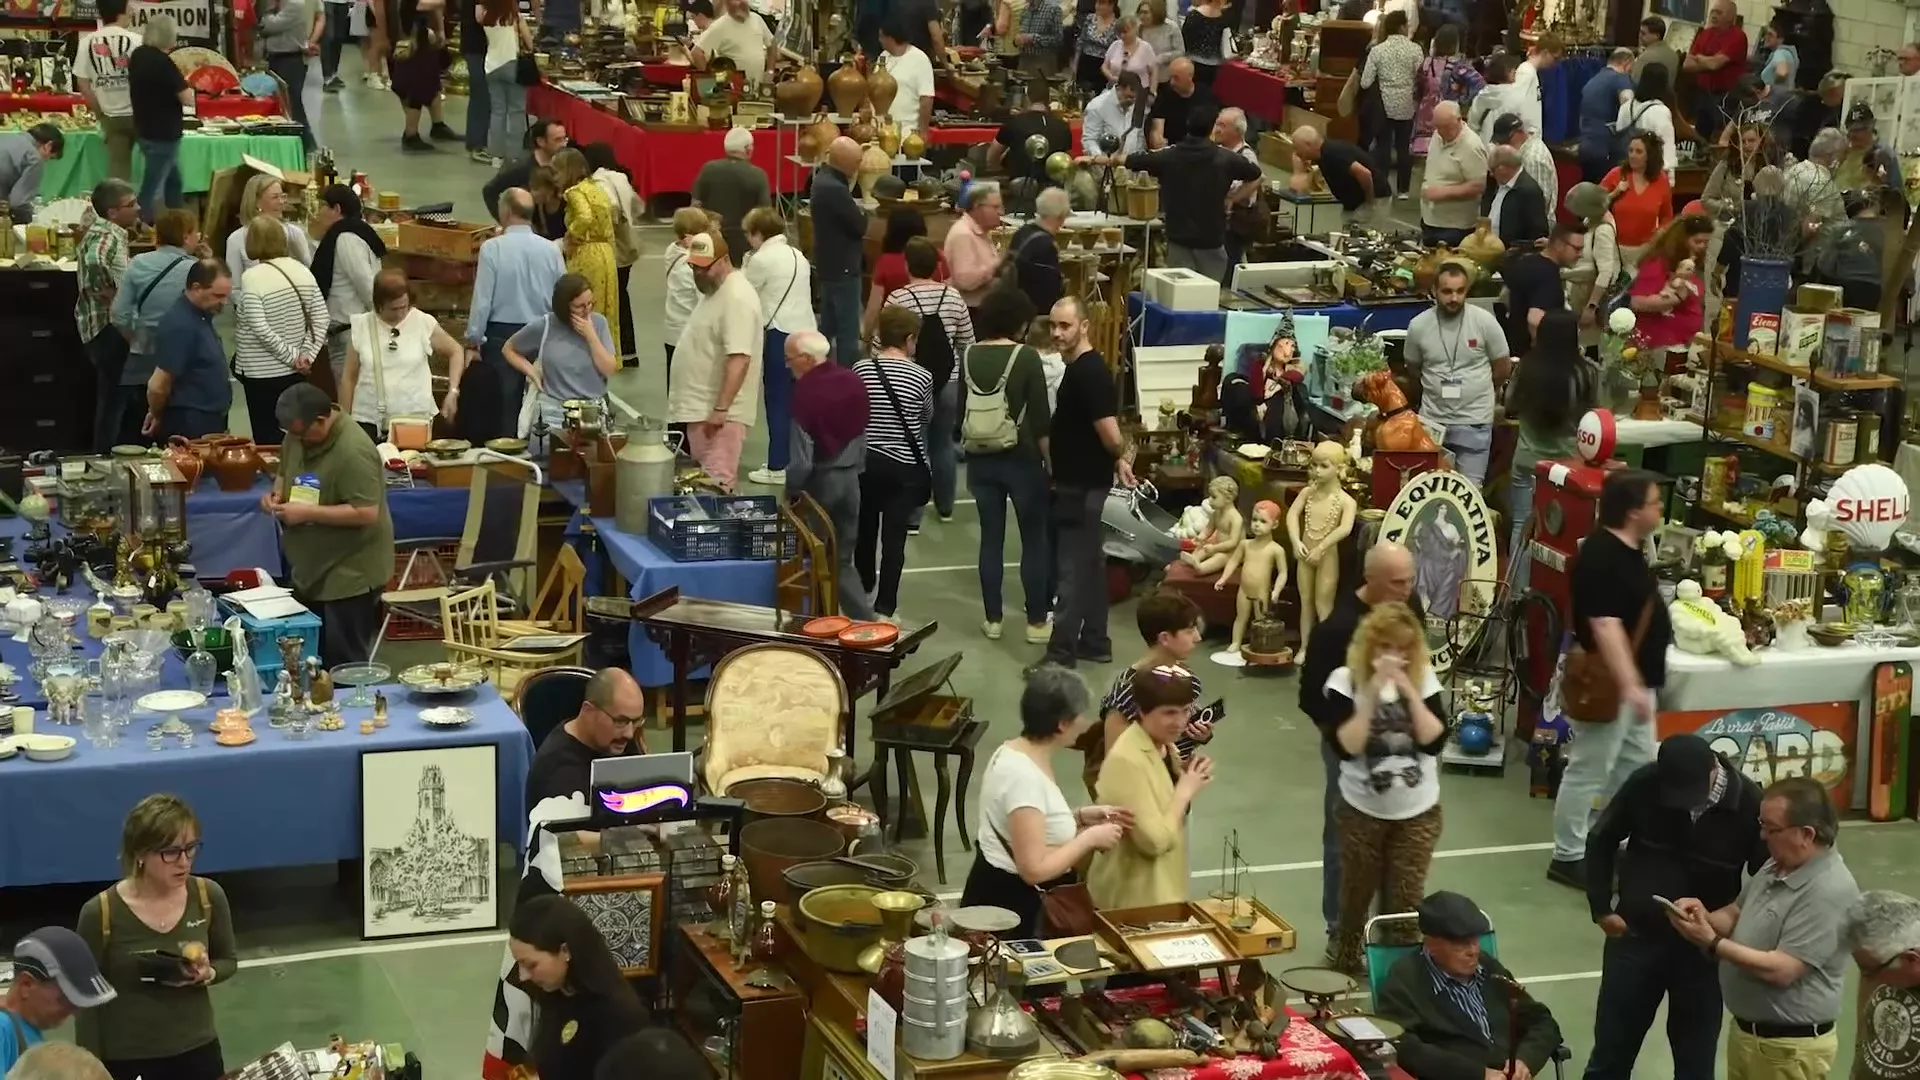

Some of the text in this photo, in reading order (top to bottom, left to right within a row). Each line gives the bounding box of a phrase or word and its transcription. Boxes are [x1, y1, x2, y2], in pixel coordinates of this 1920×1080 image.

[1752, 316, 1777, 327] Elena
[1836, 494, 1909, 522] SHELL
[1396, 476, 1491, 568] EQVITATIVA
[1704, 718, 1725, 734] Le
[1727, 720, 1757, 733] vrai
